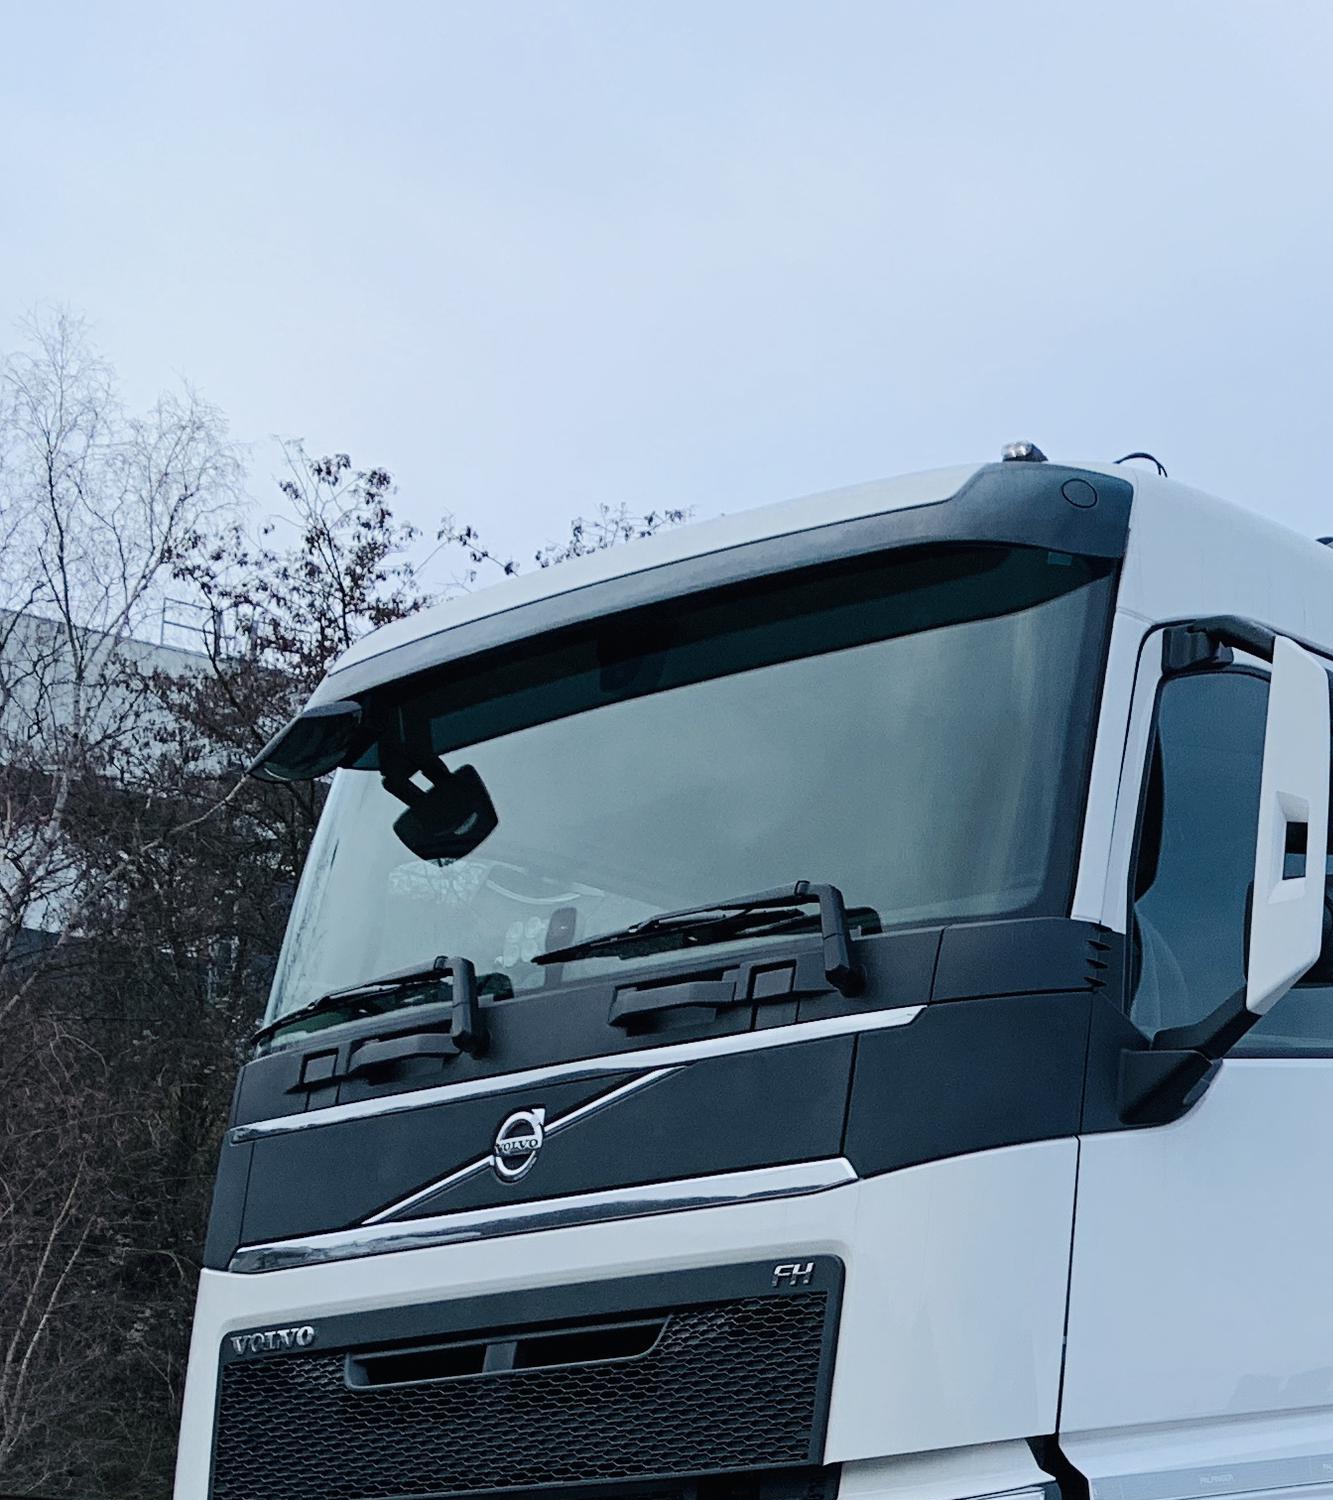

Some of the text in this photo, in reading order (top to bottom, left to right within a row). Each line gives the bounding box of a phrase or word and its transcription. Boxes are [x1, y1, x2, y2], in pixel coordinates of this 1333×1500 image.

[494, 1139, 539, 1155] VOLVO
[771, 1262, 815, 1287] FH
[230, 1325, 315, 1355] VOLVO
